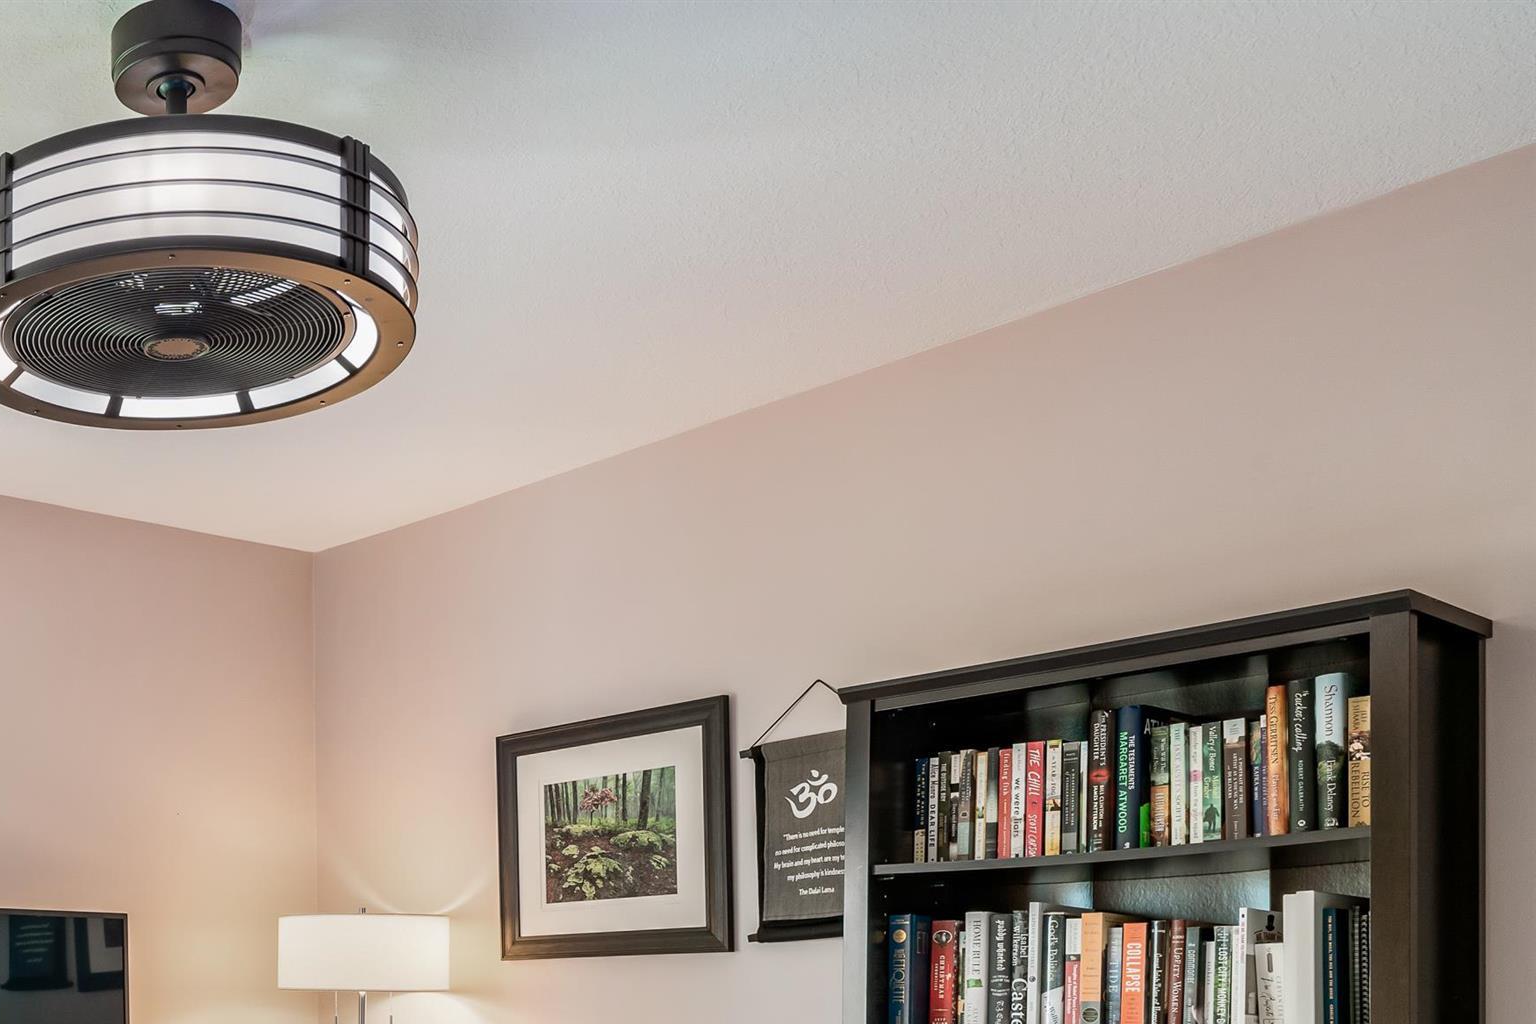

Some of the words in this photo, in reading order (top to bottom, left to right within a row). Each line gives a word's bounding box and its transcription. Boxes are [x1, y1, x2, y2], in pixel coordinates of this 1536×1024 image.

[1324, 684, 1340, 738] Shannon
[1099, 724, 1107, 766] PRESIDENT'S
[1128, 735, 1136, 748] THE
[1207, 726, 1218, 745] Valley
[1270, 716, 1280, 764] GERRITSEN
[1292, 723, 1307, 752] calling
[1002, 753, 1011, 780] finding
[1029, 749, 1040, 767] THE
[1119, 732, 1128, 786] MARGARET
[1128, 750, 1136, 790] TESTAMENTS
[1325, 759, 1336, 781] Frank
[1014, 777, 1021, 790] we
[1028, 771, 1041, 796] CHILL
[1350, 762, 1360, 818] REBELLION
[1360, 771, 1370, 791] RISE
[1324, 783, 1336, 812] Delaney
[1360, 794, 1370, 809] TO
[1119, 790, 1128, 833] ATWOOD
[1013, 818, 1022, 838] liars
[809, 886, 821, 894] Dalai
[972, 920, 982, 947] HOME
[1012, 926, 1022, 966] Wilkerson
[1019, 934, 1029, 958] Isabel
[972, 951, 982, 975] RULE
[1125, 943, 1142, 992] COLLAPSE
[1218, 947, 1228, 964] LOST
[1109, 961, 1120, 993] TIDE
[1218, 967, 1228, 980] CITY
[1172, 981, 1182, 1013] WOMEN
[1217, 988, 1227, 1015] MONKEY
